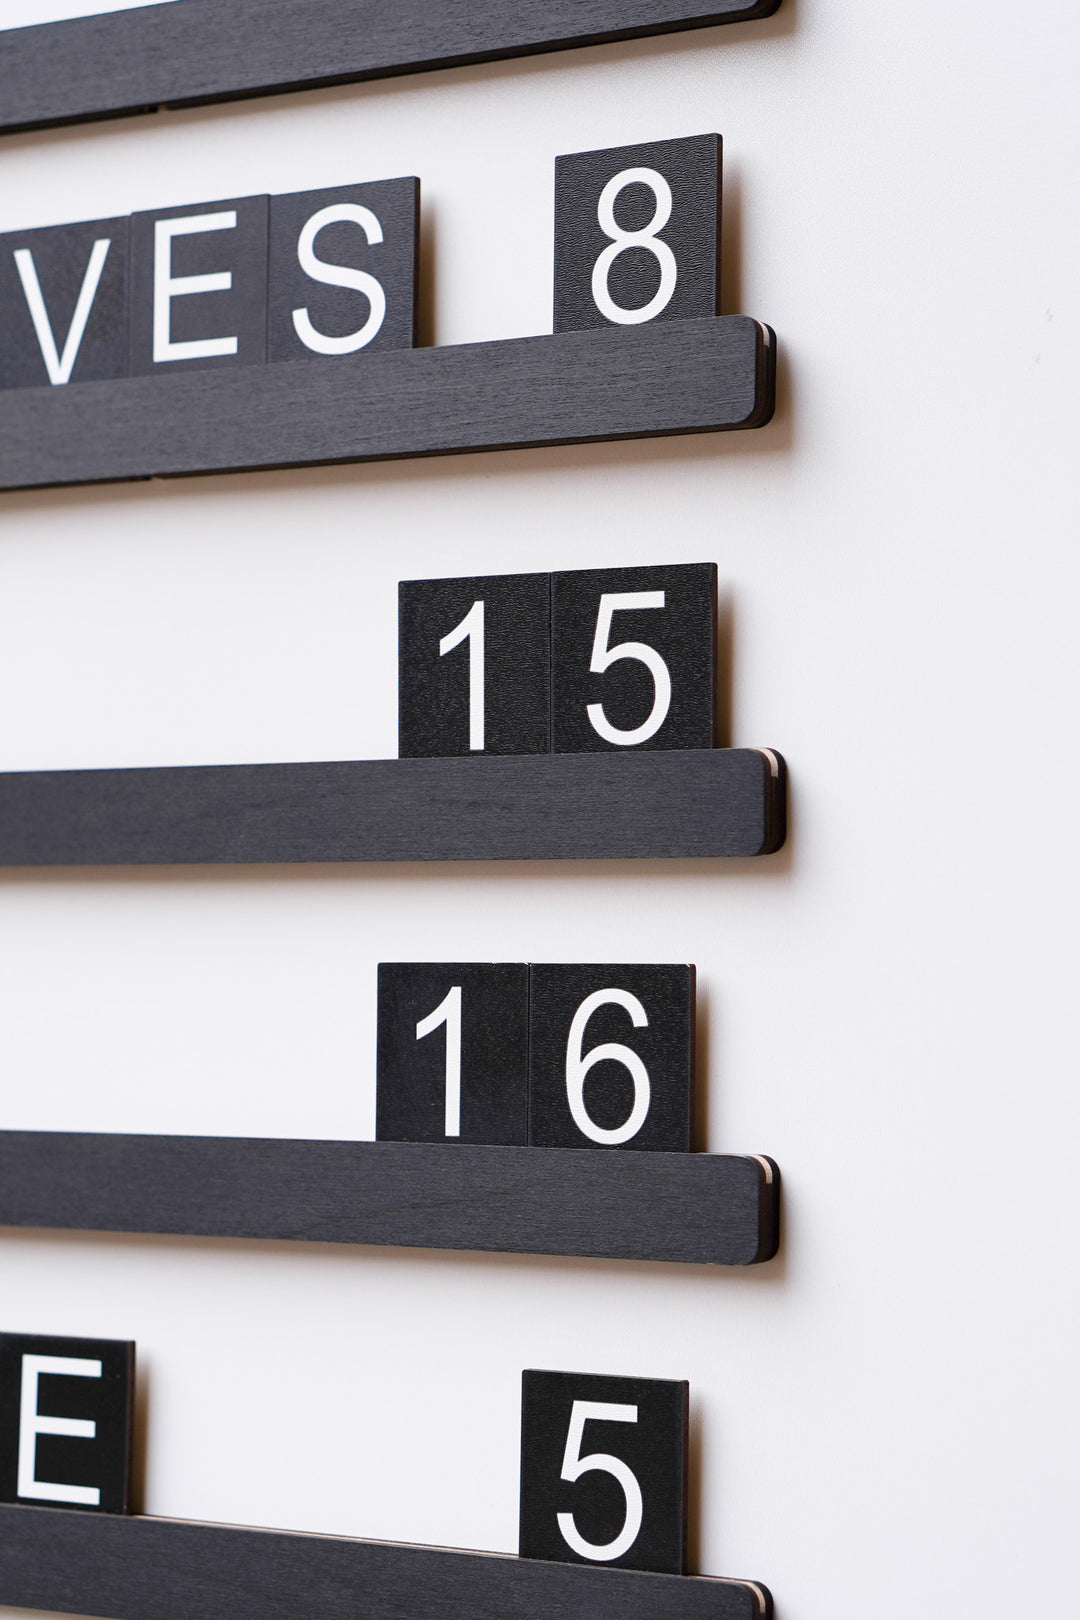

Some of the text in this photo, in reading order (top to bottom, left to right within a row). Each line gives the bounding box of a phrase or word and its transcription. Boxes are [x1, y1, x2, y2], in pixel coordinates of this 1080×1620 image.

[14, 166, 678, 386] VES 8
[439, 590, 672, 751] 15
[415, 986, 651, 1145] 16
[17, 1354, 643, 1562] E 5
